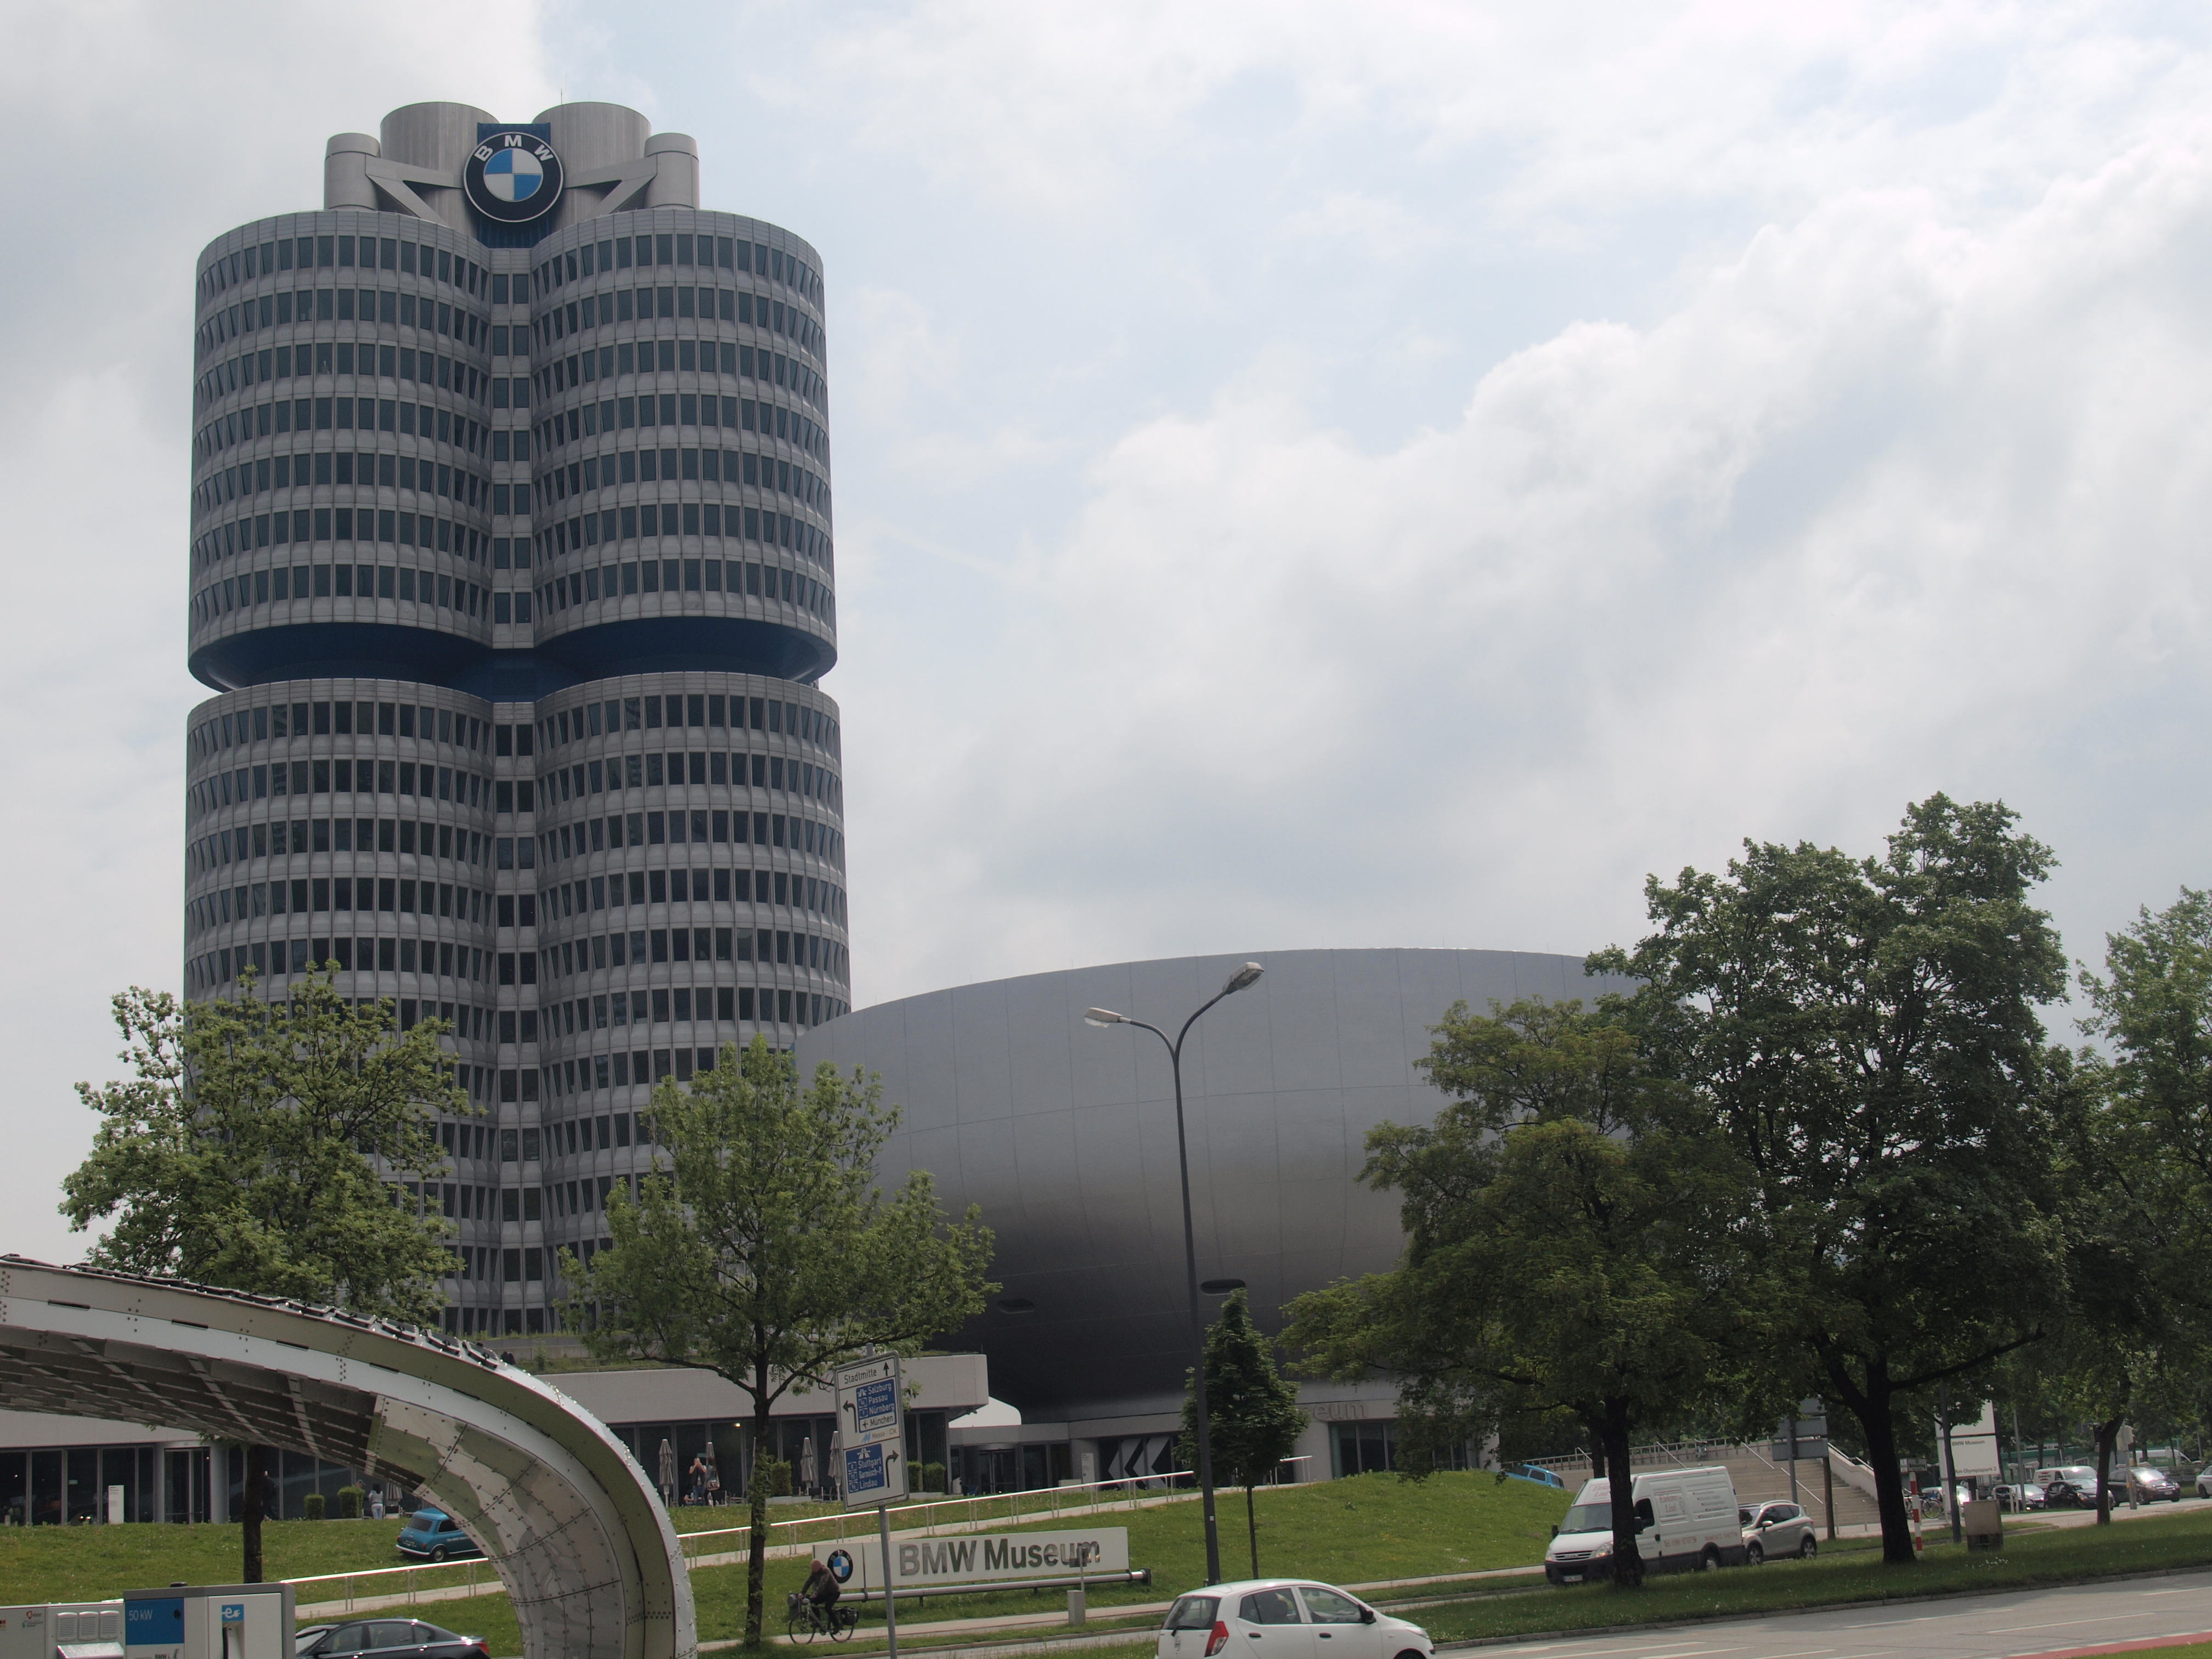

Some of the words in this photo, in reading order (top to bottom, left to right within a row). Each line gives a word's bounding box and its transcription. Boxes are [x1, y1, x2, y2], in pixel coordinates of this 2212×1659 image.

[474, 134, 554, 162] BMW
[844, 1369, 877, 1384] Stadtmitte
[868, 1383, 891, 1395] Salzburg
[868, 1394, 888, 1404] Passau
[868, 1403, 895, 1415] Nürnberg
[870, 1415, 893, 1427] München
[858, 1457, 882, 1469] Stuttgart
[859, 1479, 877, 1489] Lindau
[900, 1540, 977, 1576] BMW
[984, 1538, 1101, 1570] Museum
[129, 1610, 139, 1621] 50
[140, 1609, 153, 1620] kW
